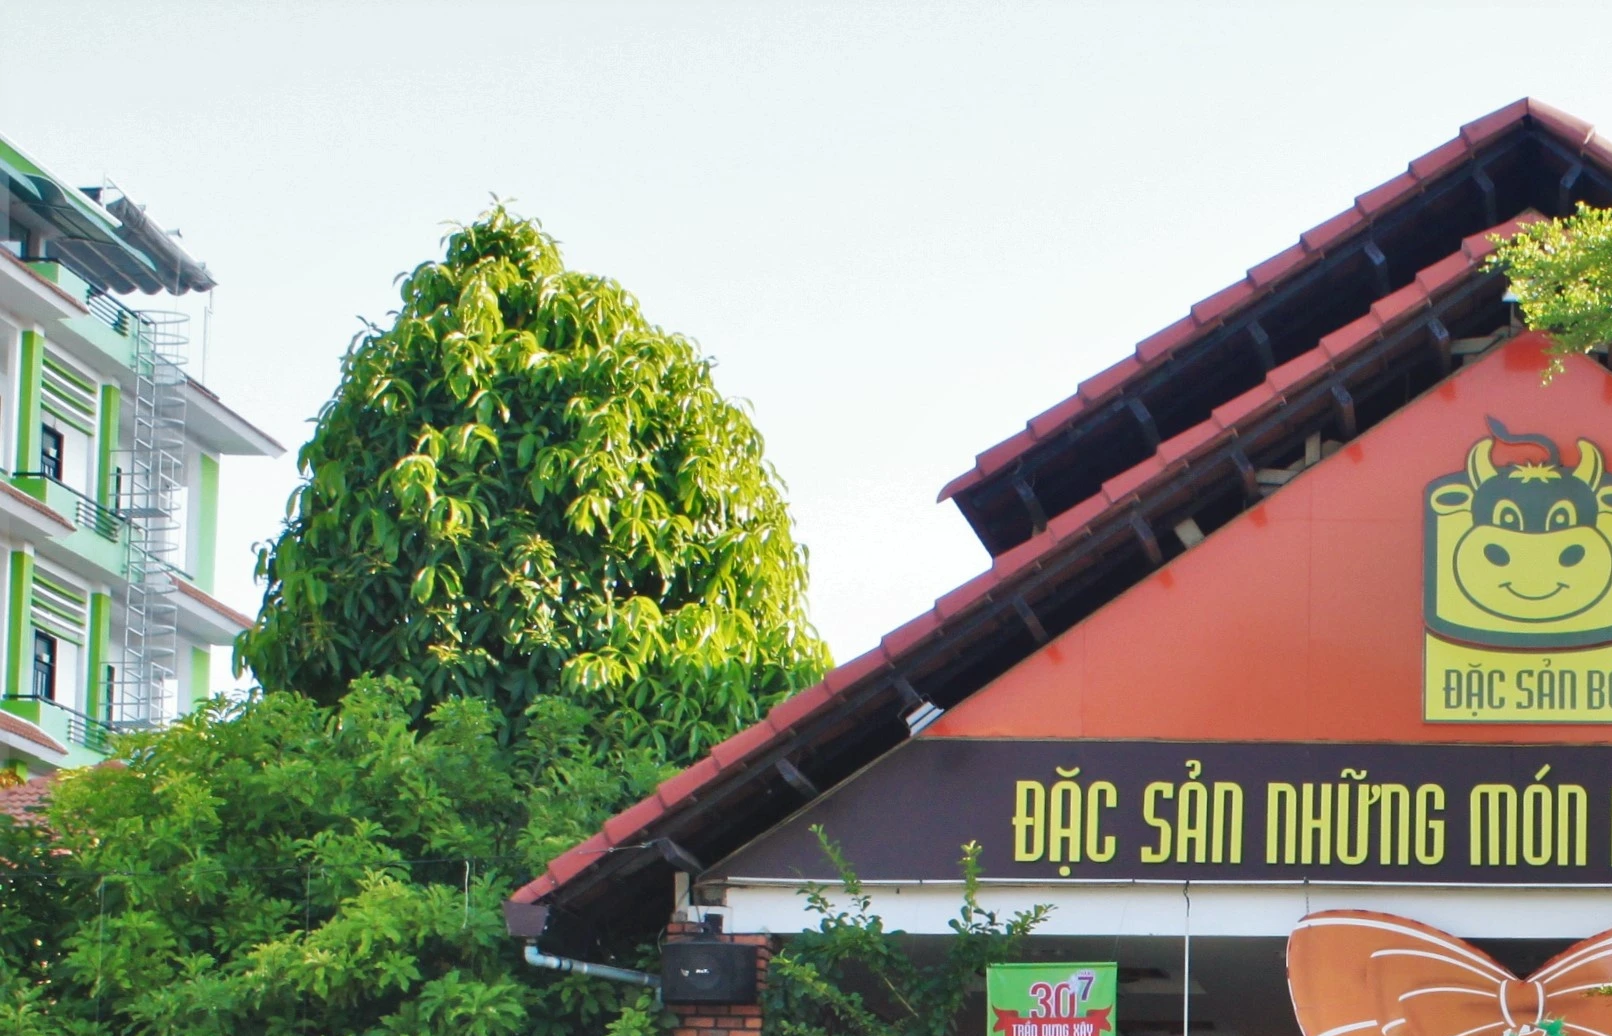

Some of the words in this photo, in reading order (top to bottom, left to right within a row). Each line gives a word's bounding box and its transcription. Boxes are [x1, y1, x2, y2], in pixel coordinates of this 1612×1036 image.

[1443, 662, 1505, 717] ĐẶC
[1516, 658, 1577, 710] SẢN
[1012, 766, 1116, 877] ĐẶC
[1141, 760, 1244, 865] SẢN
[1266, 768, 1445, 867] NHỮNG
[1470, 763, 1588, 868] MÓN
